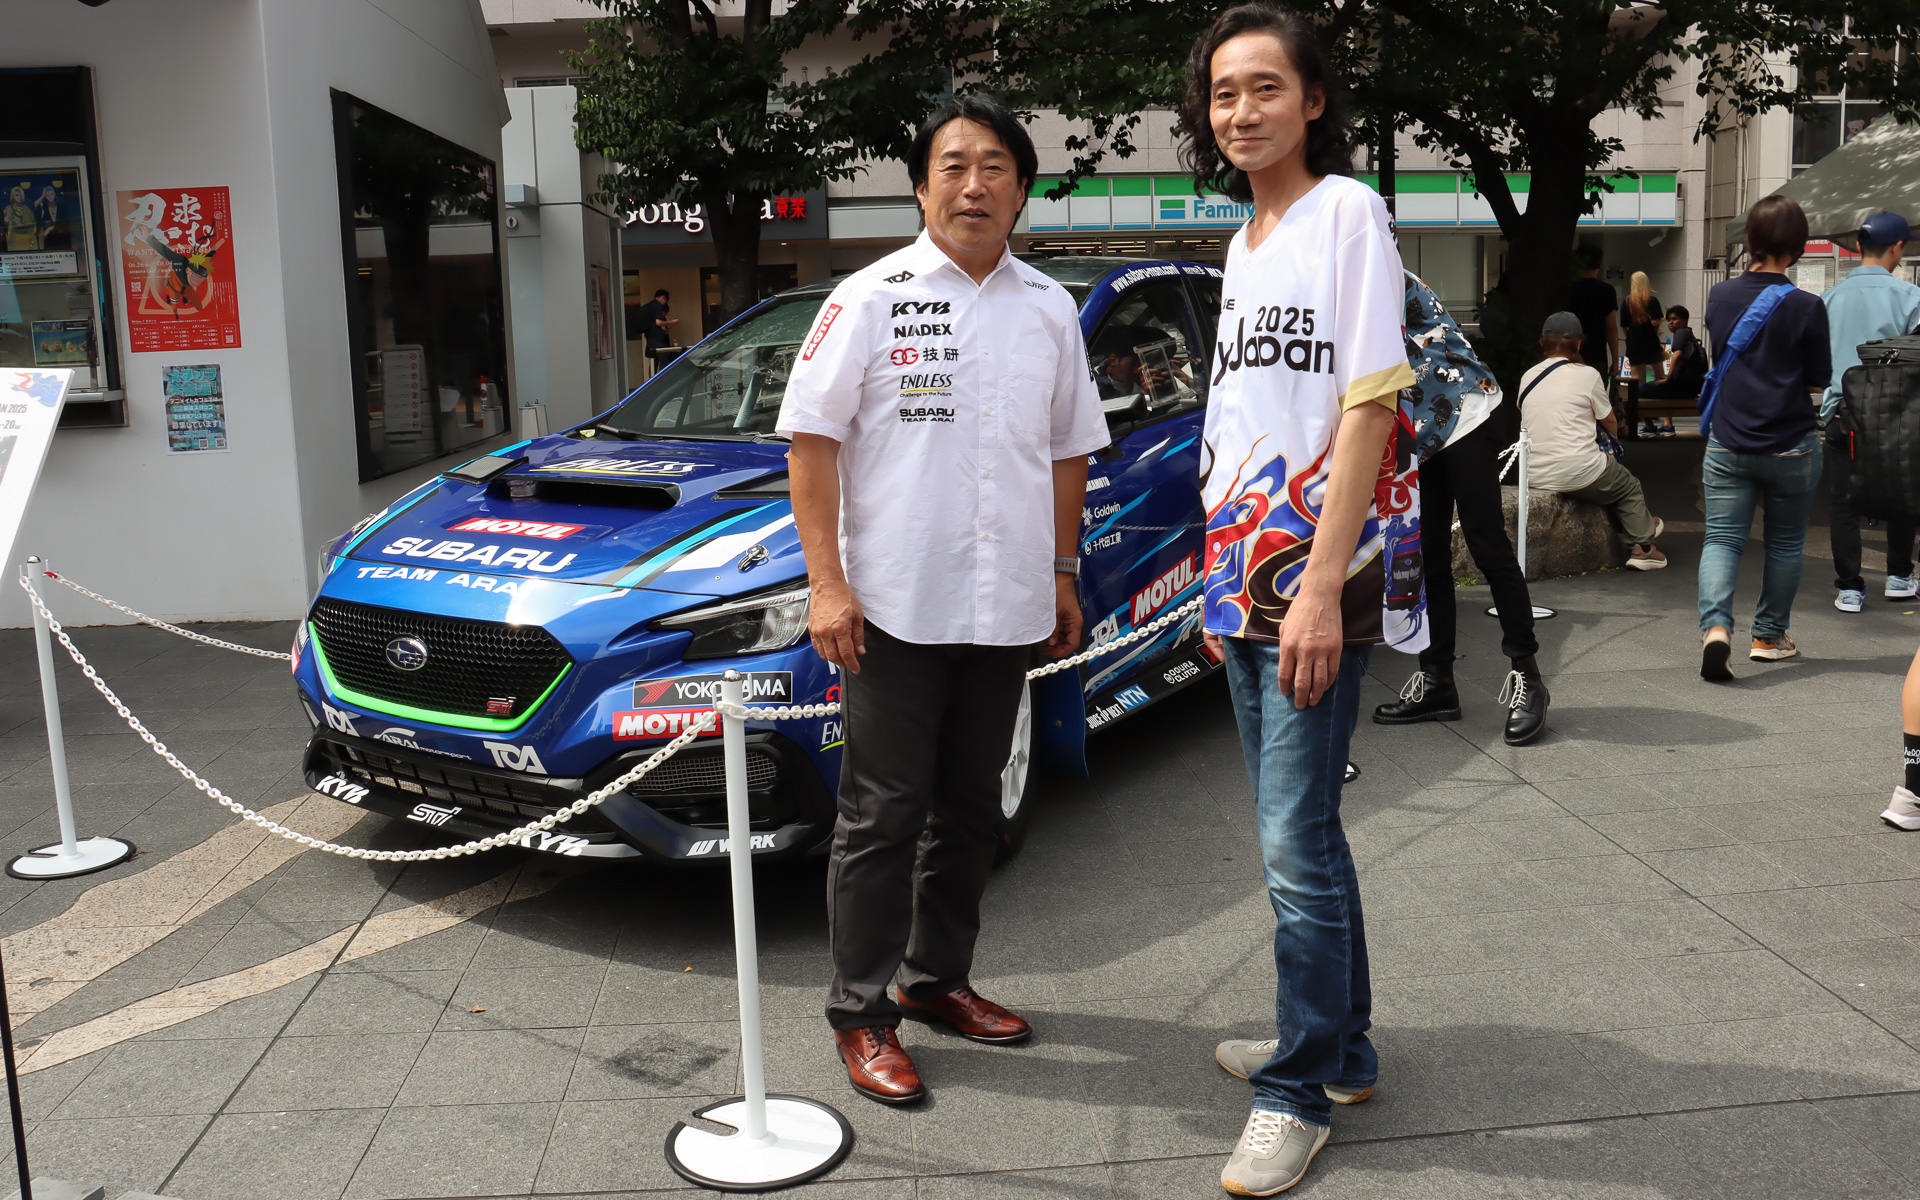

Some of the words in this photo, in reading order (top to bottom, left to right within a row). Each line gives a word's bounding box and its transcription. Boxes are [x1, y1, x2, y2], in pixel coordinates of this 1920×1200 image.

[883, 270, 915, 284] TOA
[891, 301, 951, 318] KYB
[1255, 305, 1315, 336] 2025
[804, 305, 841, 359] MOTUL
[894, 323, 953, 339] NADEX
[167, 368, 217, 382] スタッフ
[901, 373, 953, 390] ENDLESS
[8, 404, 28, 414] 2025
[899, 408, 955, 417] SUBARU
[1094, 502, 1121, 519] Goldwin
[463, 519, 577, 538] MOTUL
[1093, 531, 1122, 551] 千代田工業
[381, 537, 578, 573] SUBARU
[356, 565, 438, 581] TEAM
[446, 574, 525, 598] ARA
[1134, 557, 1194, 624] MOTUL
[1174, 666, 1200, 682] CLUTCH
[1114, 685, 1150, 709] NTN
[321, 700, 360, 737] TOA
[1106, 704, 1125, 718] NEXT
[382, 733, 419, 750] ARAI
[419, 746, 472, 761] motorsport
[483, 741, 548, 774] TOA
[314, 775, 370, 804] KYB
[719, 833, 776, 853] WRK
